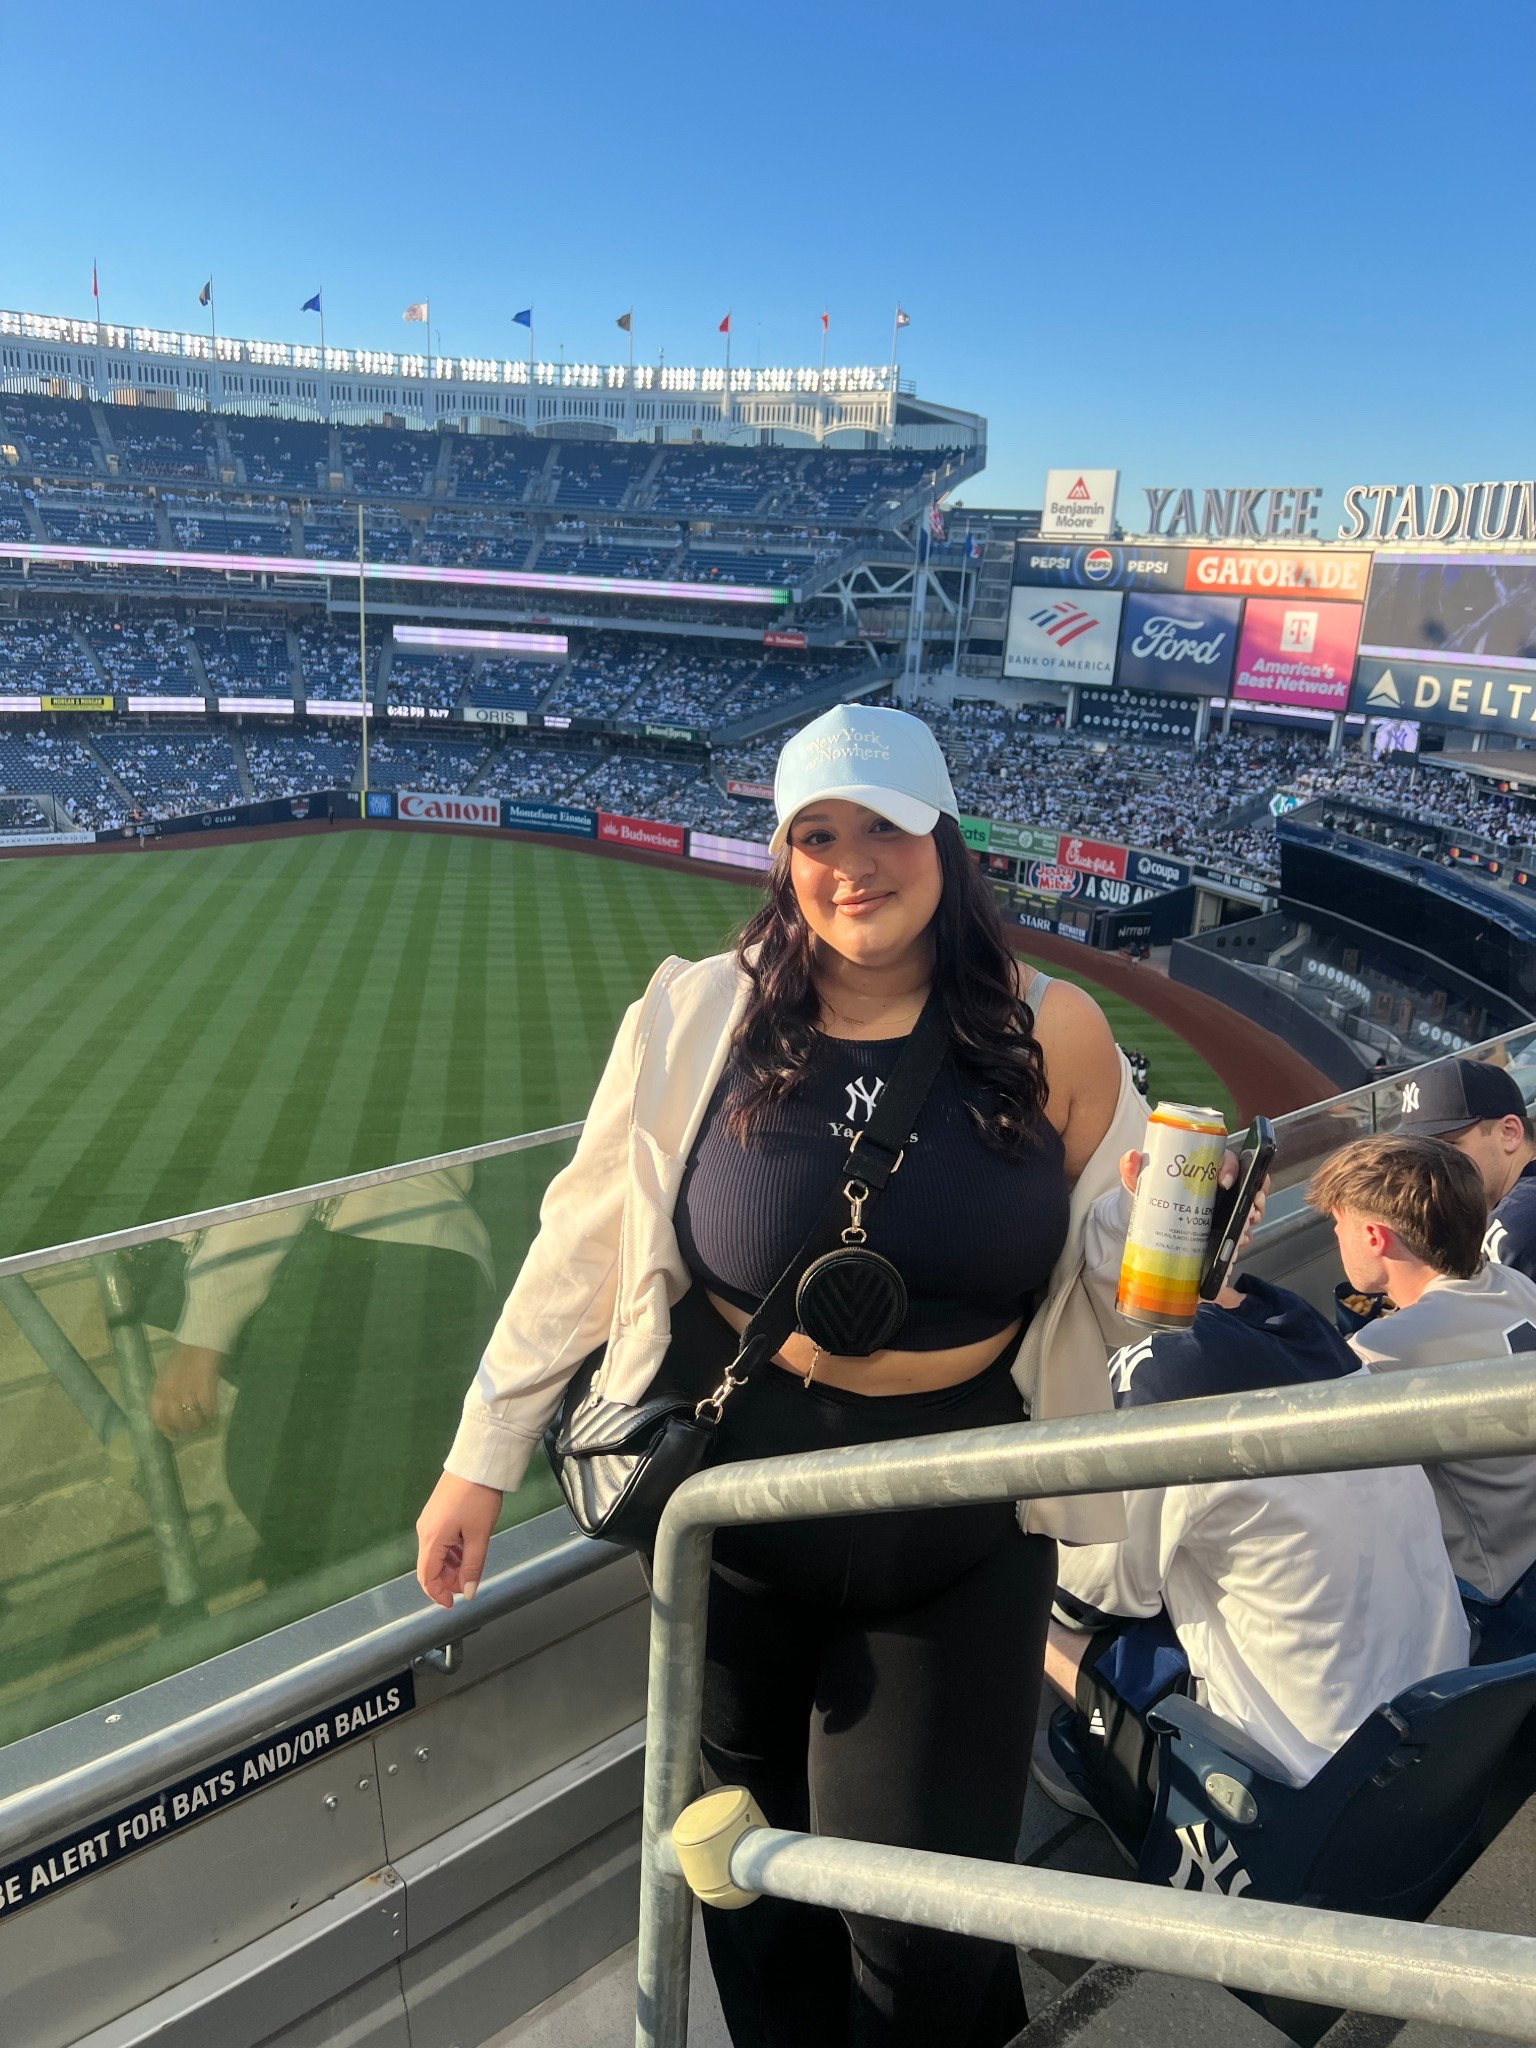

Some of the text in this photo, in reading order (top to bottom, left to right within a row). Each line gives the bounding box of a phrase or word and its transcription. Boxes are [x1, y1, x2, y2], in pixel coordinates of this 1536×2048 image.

[1051, 502, 1104, 517] Benjamin
[1143, 487, 1323, 537] YANKEE
[1056, 515, 1094, 527] Moore
[1031, 556, 1071, 569] PEPSI
[1087, 560, 1111, 569] PEPSI
[1127, 560, 1168, 574] PEPSI
[1197, 556, 1361, 590] GATORADE
[1131, 616, 1226, 665] Ford
[1008, 655, 1112, 672] BANK OF AMERICA
[1252, 658, 1335, 679] America's
[1237, 672, 1347, 697] Best Network
[1414, 675, 1536, 722] DELT
[476, 710, 515, 724] ORIS
[807, 728, 889, 753] New York
[820, 743, 891, 762] Nowhere
[214, 815, 237, 824] CLEAR
[400, 796, 498, 823] Canon
[510, 805, 558, 820] Montefiore
[560, 811, 592, 825] Einstein
[620, 826, 680, 849] Budweiser
[1151, 862, 1180, 882] coupa
[1086, 876, 1096, 898] A
[1100, 879, 1130, 905] SUB
[1020, 913, 1051, 932] STARR
[845, 1076, 885, 1122] NY
[1401, 1081, 1420, 1113] NY
[1150, 1198, 1170, 1209] ICED
[1173, 1202, 1192, 1213] TEA
[1195, 1206, 1200, 1215] &
[1186, 1216, 1210, 1226] VODKA
[30, 1830, 111, 1894] ALERT
[117, 1804, 167, 1849] FOR
[172, 1769, 236, 1821] BATS
[242, 1722, 330, 1787] AND/OR
[335, 1687, 401, 1738] BALLS
[1225, 1789, 1235, 1808] 1
[1168, 1819, 1253, 1897] NY
